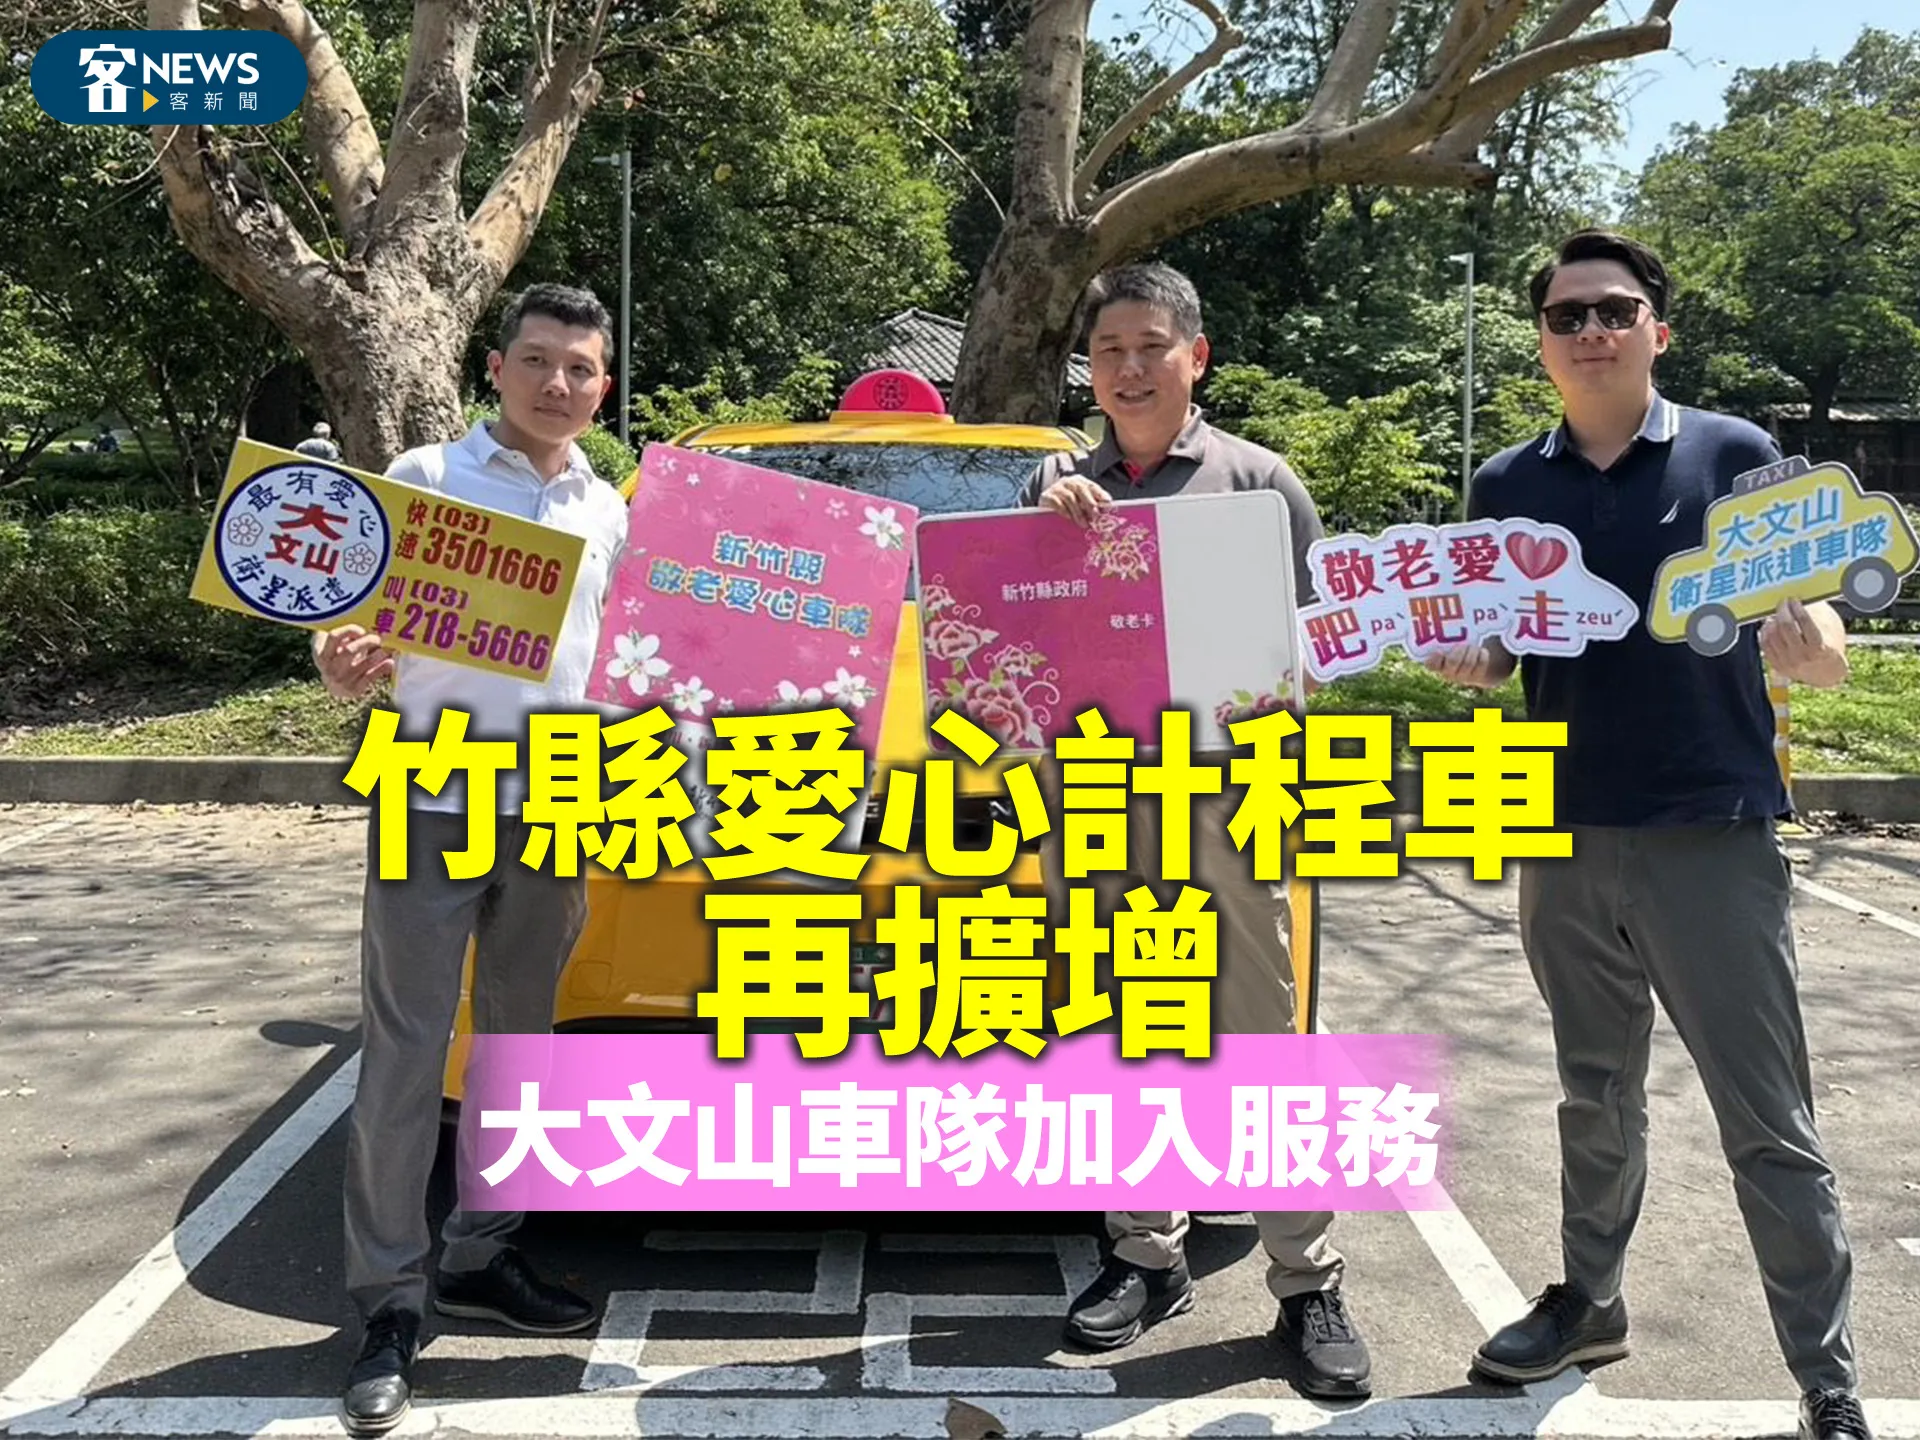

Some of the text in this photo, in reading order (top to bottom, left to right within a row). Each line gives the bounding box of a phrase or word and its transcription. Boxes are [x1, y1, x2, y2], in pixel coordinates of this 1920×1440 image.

[246, 470, 377, 538] 最有愛心
[1743, 461, 1796, 489] TAXI
[1716, 487, 1840, 558] 大文山
[422, 526, 562, 595] 3501666
[713, 530, 826, 584] 新竹縣
[1002, 579, 1088, 602] 新竹縣政府
[1669, 514, 1888, 613] 衛星派遣車隊
[647, 555, 873, 637] 敬老愛心車隊
[1110, 613, 1154, 630] 敬老卡
[1514, 590, 1570, 642] 走
[398, 603, 551, 672] 218-5666
